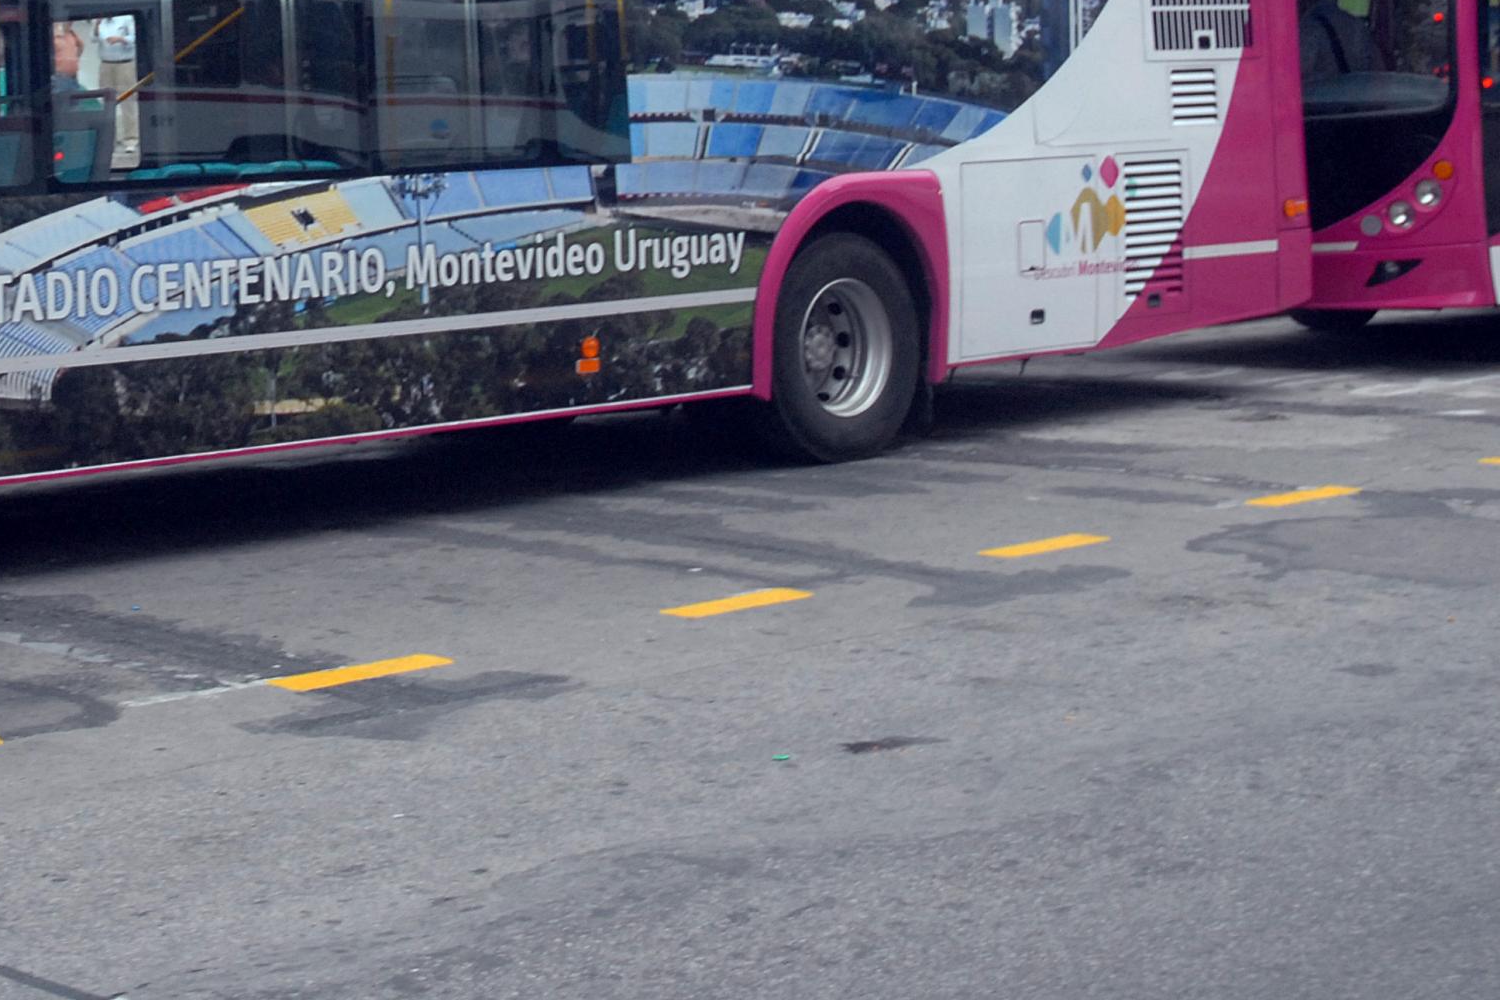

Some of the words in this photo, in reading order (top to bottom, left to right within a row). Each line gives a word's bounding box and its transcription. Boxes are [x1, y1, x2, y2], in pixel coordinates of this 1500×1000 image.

[130, 246, 395, 314] CENTENARIO,
[405, 232, 604, 290] Montevideo
[614, 228, 746, 280] Uruguay
